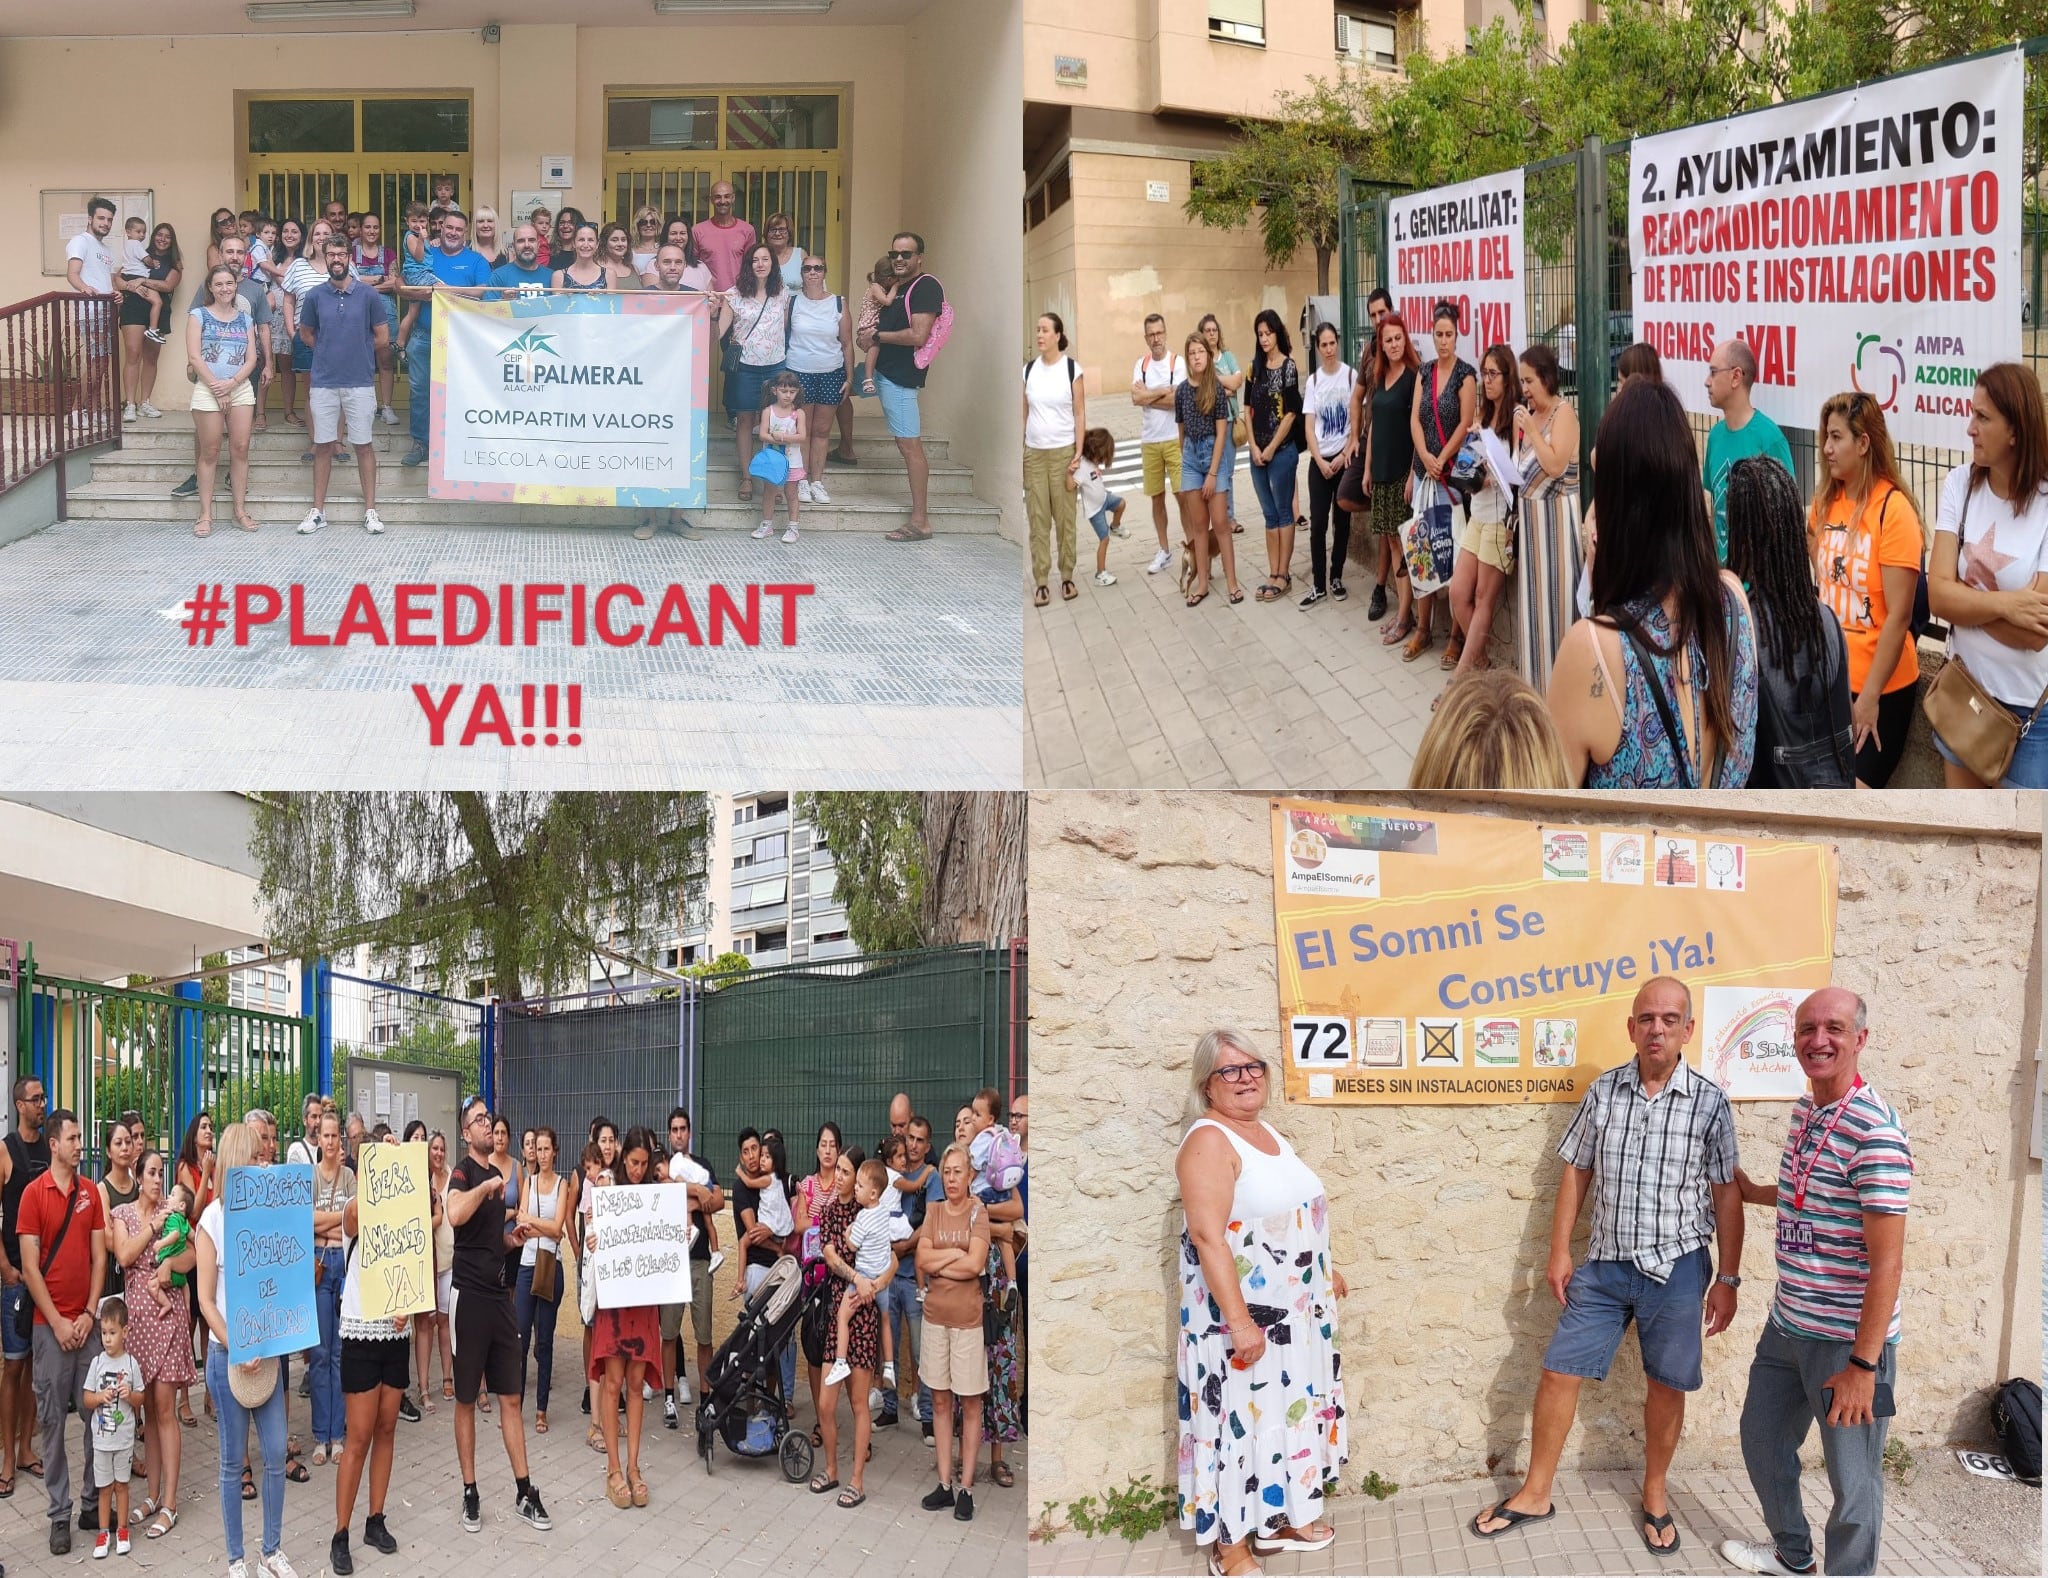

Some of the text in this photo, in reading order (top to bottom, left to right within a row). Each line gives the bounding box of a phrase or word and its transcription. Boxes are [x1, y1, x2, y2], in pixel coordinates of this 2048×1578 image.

[1641, 101, 1996, 203] 2. AYUNTAMIENTO:
[1394, 189, 1518, 241] 1. GENERALITAT:
[1642, 170, 1999, 256] REACONDICIONAMIENTO
[1398, 235, 1514, 285] RETIRADA DEL
[1643, 246, 1996, 304] DE PATIOS E INSTALACIONES
[1399, 294, 1471, 336] AMIAO
[503, 354, 522, 363] CEIP
[1914, 335, 1965, 356] AMPA
[503, 364, 643, 385] EL PALMERAL
[503, 384, 545, 393] ALACANT
[464, 409, 674, 430] COMPARTIM VALORS
[463, 449, 673, 471] L'ESCOLA QUE SOMIEM
[1351, 822, 1363, 830] DE
[1291, 871, 1352, 884] AmpaElSomni
[1294, 904, 1545, 970] El Somni Se
[1438, 931, 1716, 1010] Construye ¡Ya!
[1293, 1022, 1349, 1059] 72
[1335, 1079, 1574, 1093] MESES SIN INSTALACIONES DIGNAS
[363, 1144, 415, 1206] FUERA
[596, 1190, 643, 1217] MEJORA
[361, 1217, 426, 1269] AMIANTO
[613, 1256, 632, 1279] LOS
[259, 1278, 277, 1299] DE
[384, 1260, 425, 1314] YA!
